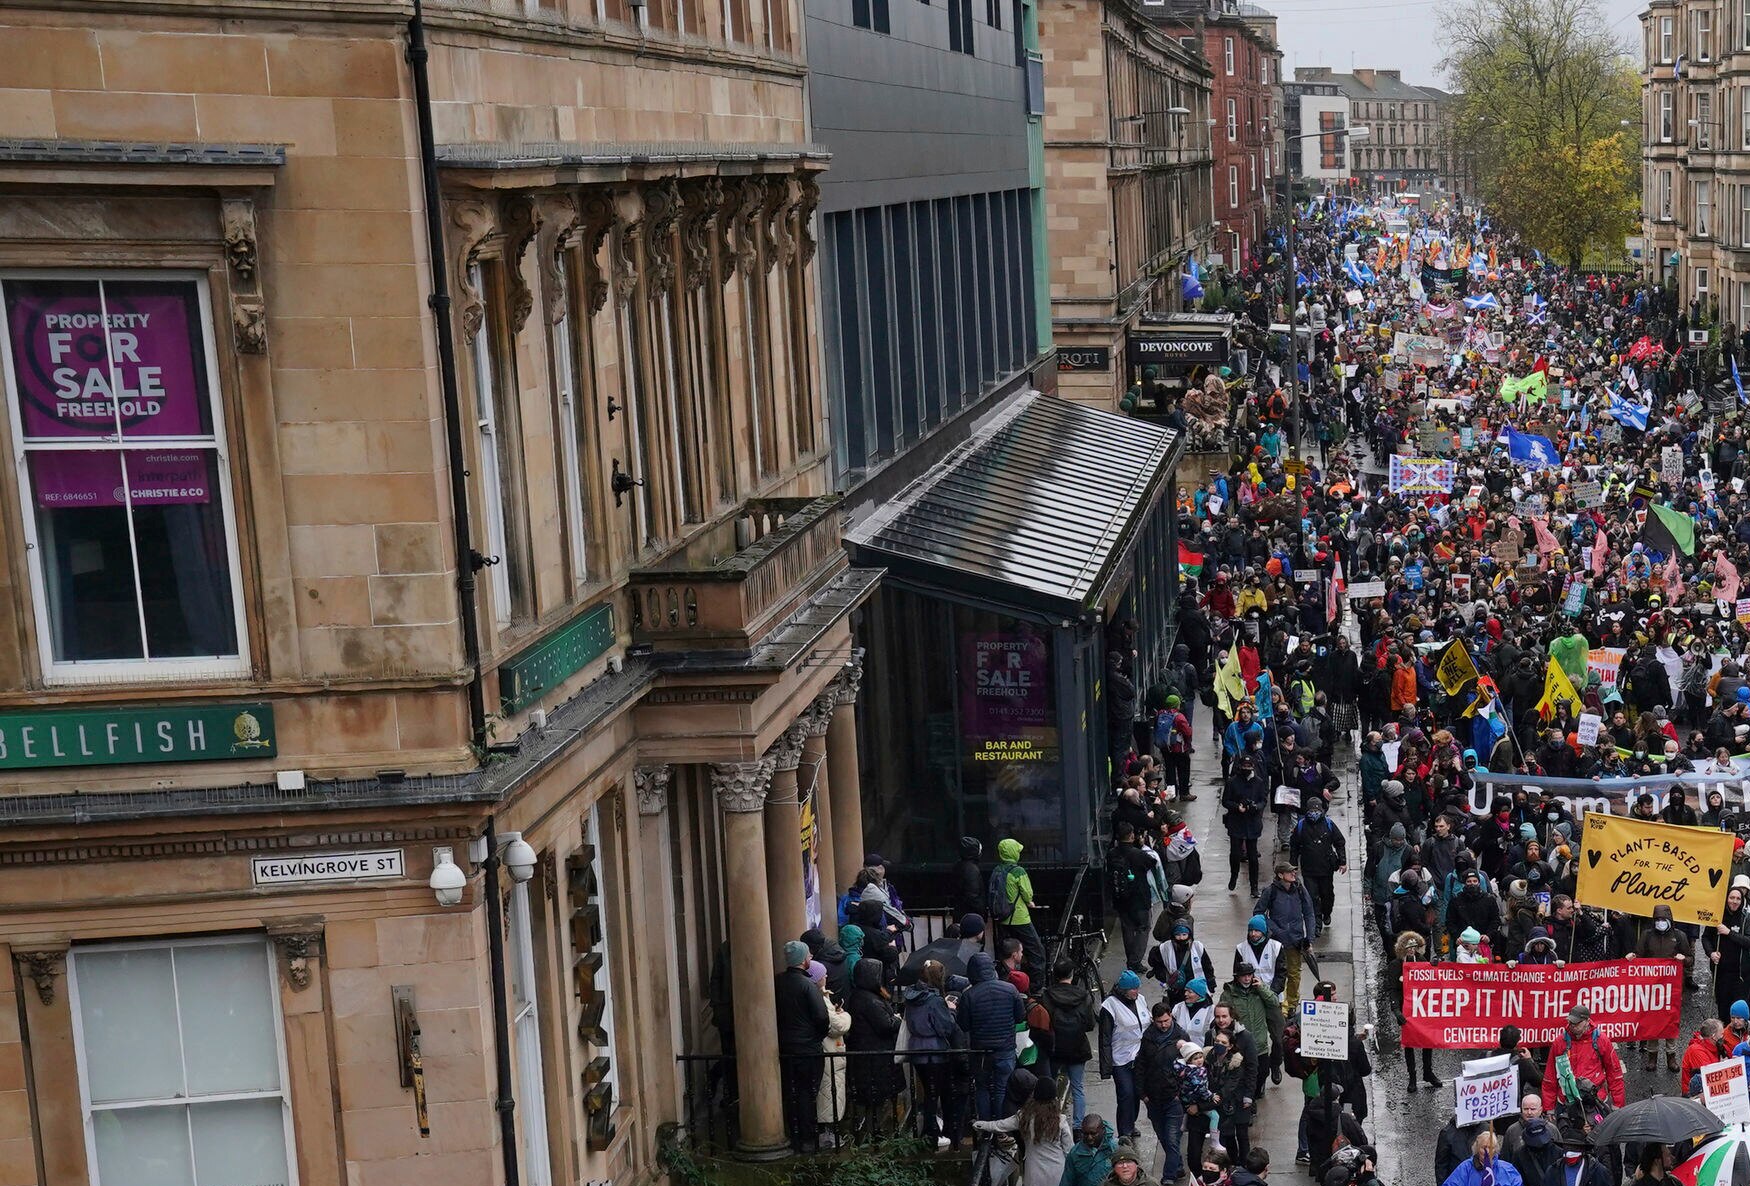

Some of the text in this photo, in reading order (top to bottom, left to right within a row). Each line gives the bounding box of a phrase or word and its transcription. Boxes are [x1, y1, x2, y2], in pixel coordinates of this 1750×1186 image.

[46, 313, 150, 329] PROPERTY
[48, 332, 141, 363] FOR
[1140, 342, 1212, 353] DEVONCOVE
[53, 366, 165, 399] SALE
[56, 401, 160, 417] FREEHOLD
[977, 642, 1029, 650] PROPERTY
[977, 670, 1031, 687] SALE
[977, 687, 1028, 697] FREEHOLD
[985, 741, 1032, 750] BAR AND
[975, 751, 1043, 761] RESTAURANT
[1610, 838, 1700, 874] PLANT-BASED
[260, 857, 396, 879] KELVINGROVE ST
[1634, 859, 1675, 872] FOR THE
[1611, 870, 1690, 902] Planet
[1409, 965, 1676, 984] FOSSIL FUELS CLIMATE CHANGE CLIMATE CHANGE EXTINCTION
[1411, 983, 1673, 1019] KEEP IT IN THE GROUND!
[1443, 1027, 1489, 1043] CENTER
[1460, 1074, 1513, 1097] NO MORE
[1705, 1071, 1723, 1084] KEEP
[1710, 1082, 1730, 1097] ALIVE
[1465, 1089, 1510, 1111] FOSSIL
[1471, 1100, 1509, 1120] FUELS
